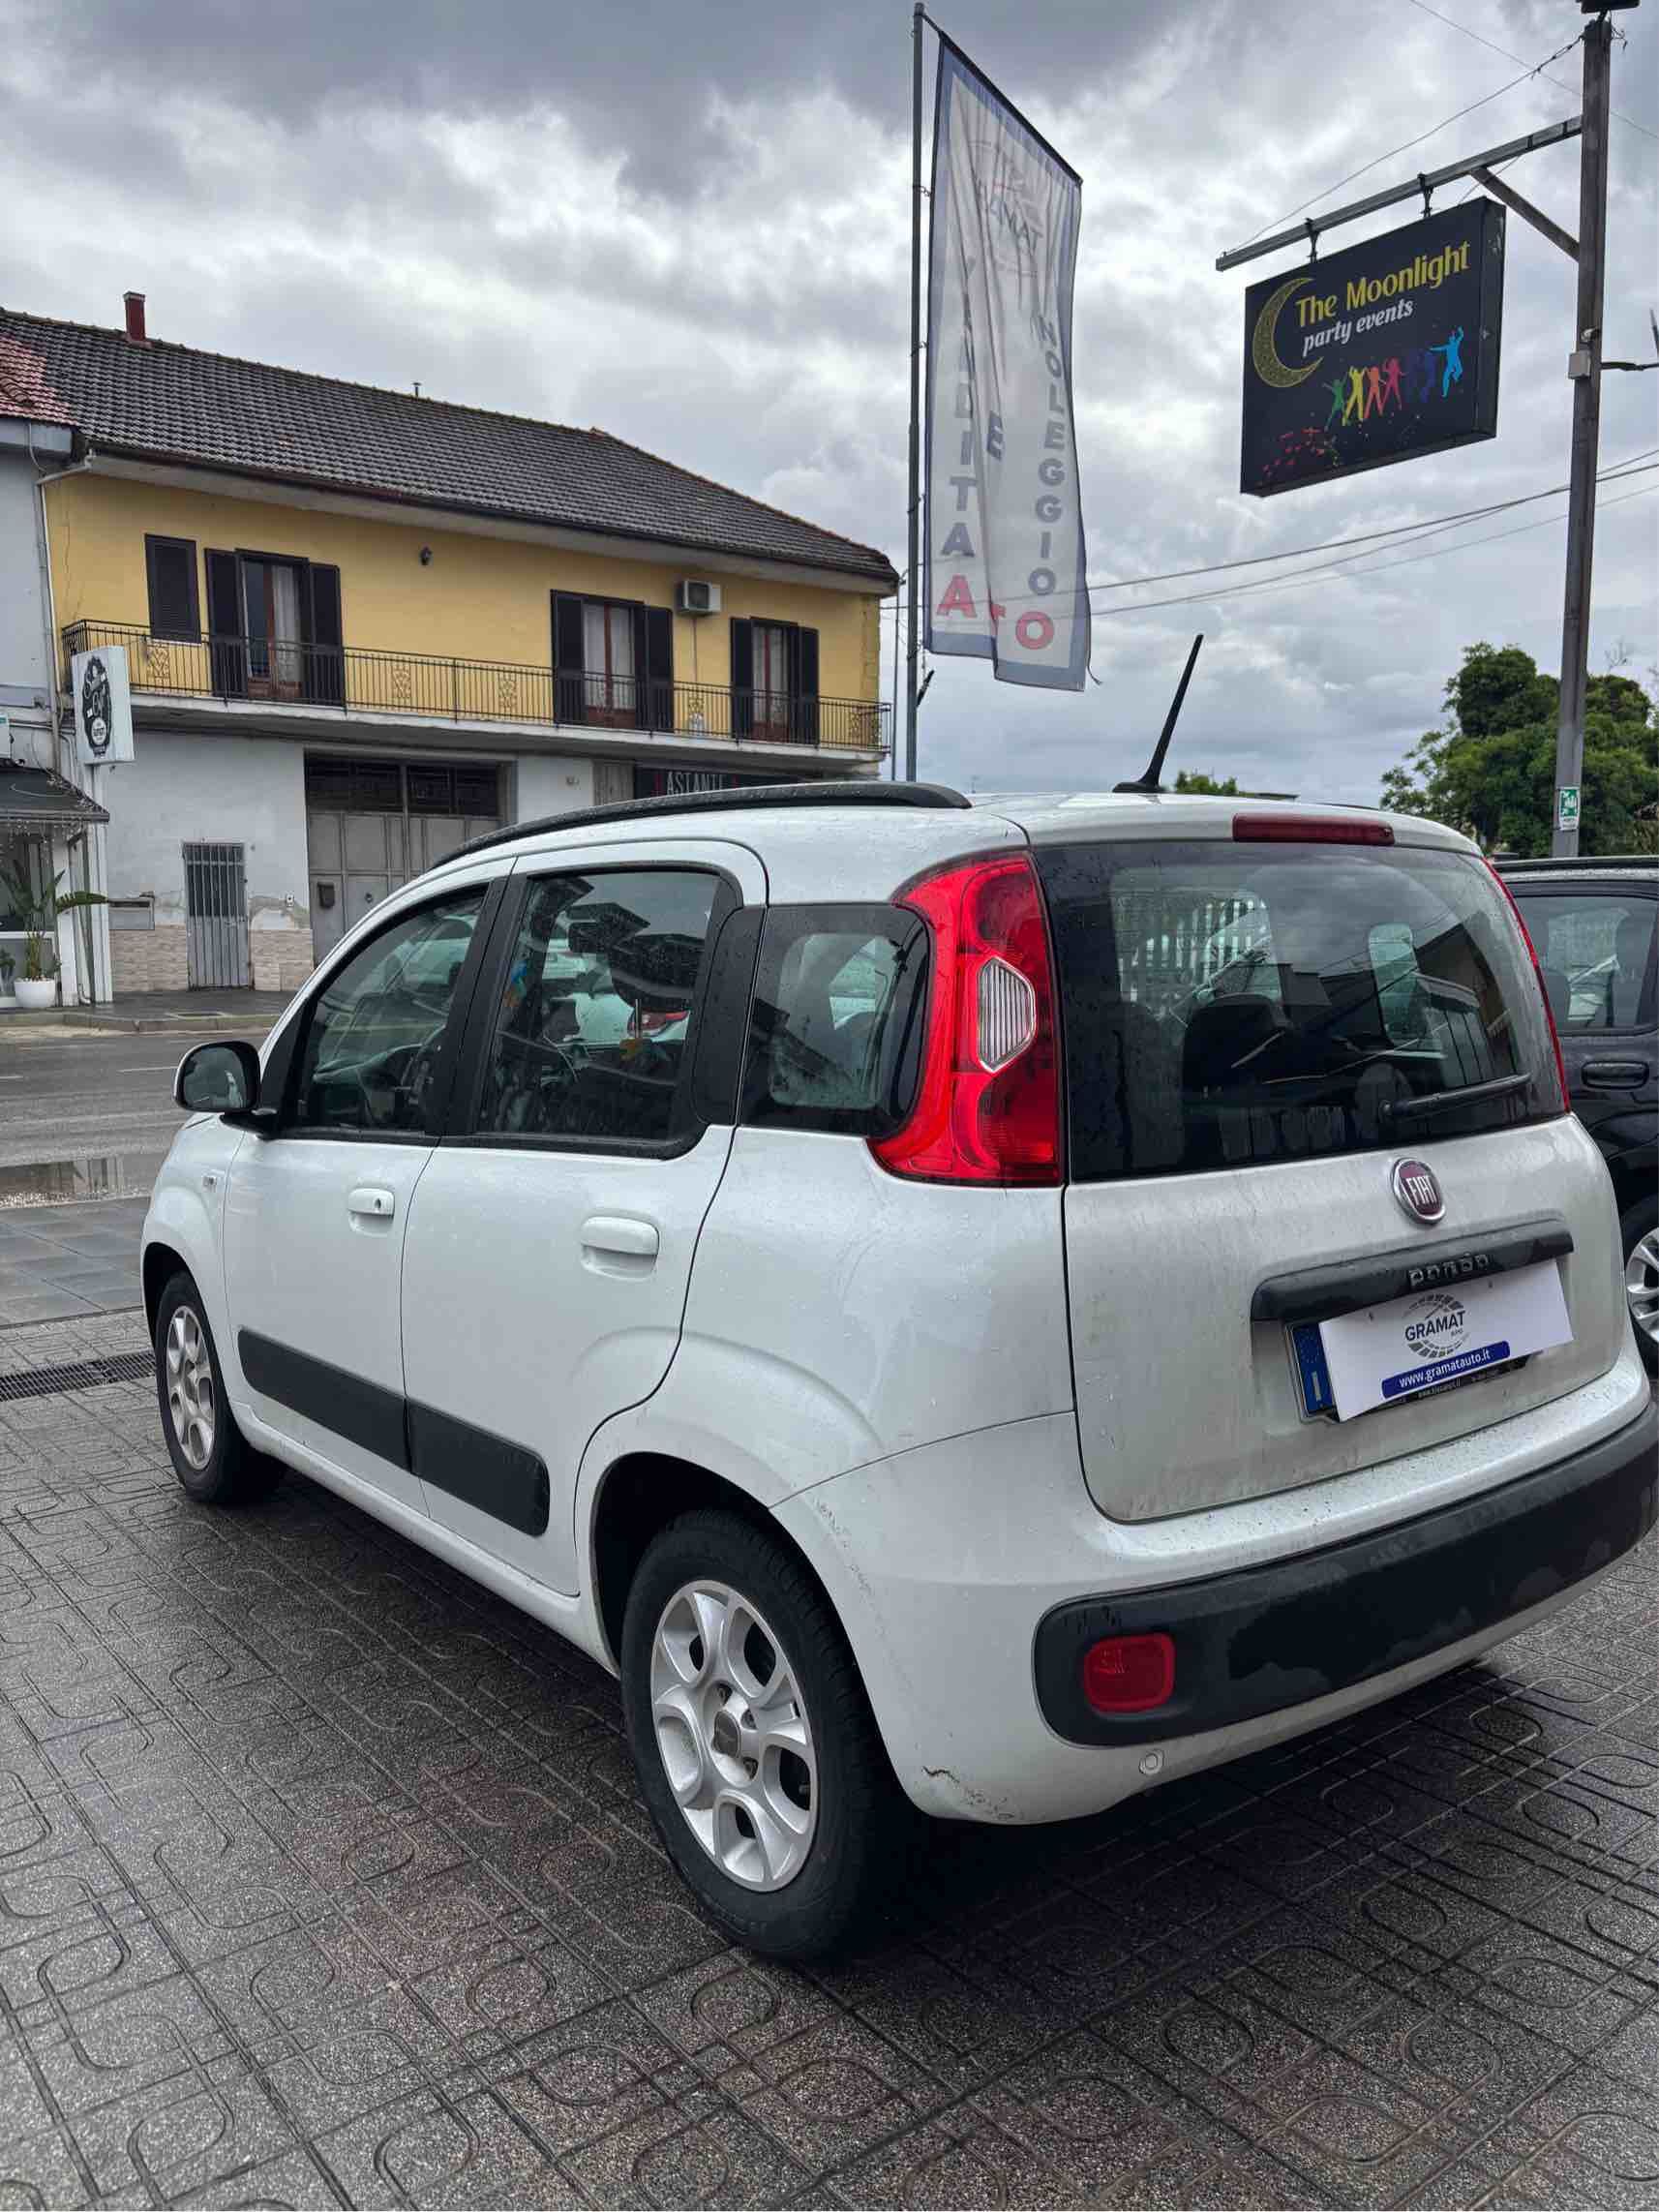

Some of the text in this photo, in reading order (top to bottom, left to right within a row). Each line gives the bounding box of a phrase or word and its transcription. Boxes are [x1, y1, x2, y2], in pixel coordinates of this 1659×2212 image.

[1295, 240, 1471, 327] The Moonlight
[1303, 298, 1414, 357] party events
[1405, 1175, 1437, 1206] FIAT
[1404, 1310, 1466, 1342] GRAMAT
[1399, 1348, 1491, 1389] www.gramatauto.it
